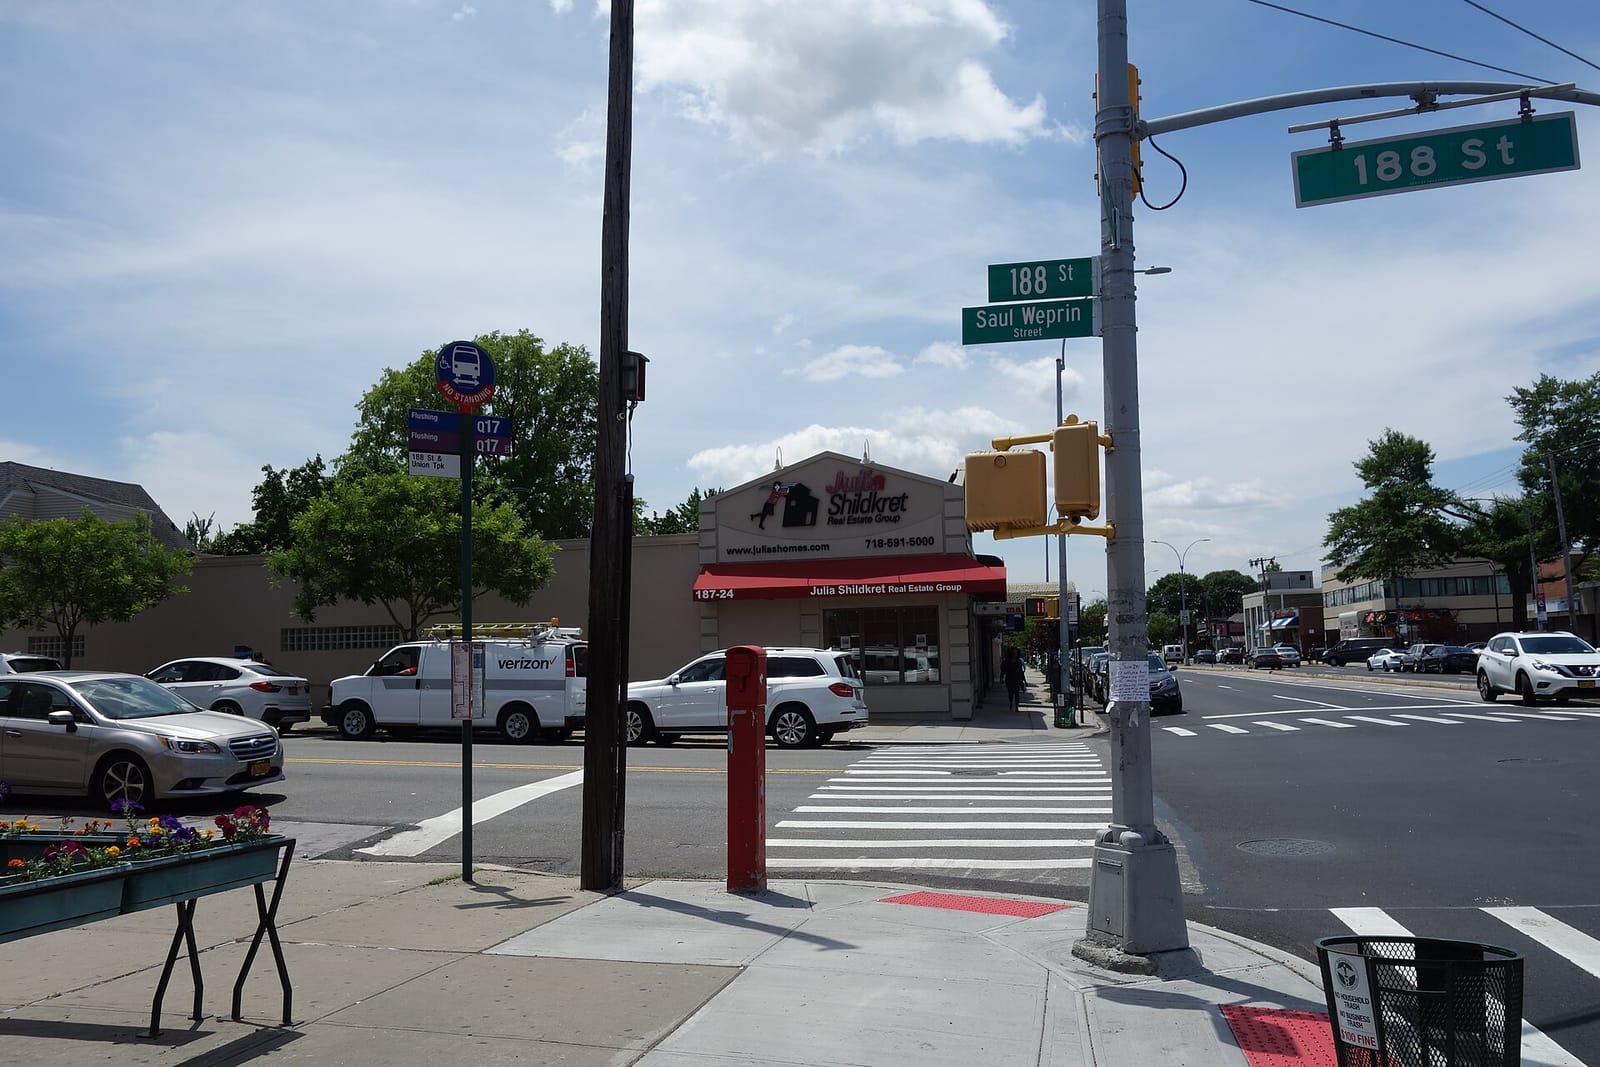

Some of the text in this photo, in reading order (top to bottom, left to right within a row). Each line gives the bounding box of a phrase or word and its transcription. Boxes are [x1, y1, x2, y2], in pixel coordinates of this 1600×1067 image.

[1353, 135, 1515, 185] 188 St
[1010, 264, 1073, 296] 188 St
[976, 304, 1081, 328] Saul Weprin
[1013, 327, 1042, 338] Street
[443, 383, 492, 404] NO STANDING
[411, 412, 438, 423] Flushing
[477, 420, 501, 435] Q17
[411, 431, 438, 442] Flushing
[476, 438, 499, 453] Q17
[412, 453, 425, 461] 188
[433, 462, 445, 470] Tpk
[825, 469, 886, 494] Julia
[827, 491, 908, 516] Shildkret
[827, 513, 900, 525] Real Estate Group
[865, 536, 935, 549] 718-591-5000
[726, 543, 830, 556] www.juliashomes.com
[695, 588, 734, 599] 187-24
[810, 583, 962, 596] Julia Shildkret Real Estate Group
[498, 656, 550, 670] verizon
[1341, 994, 1369, 1004] HOUSEHOLD
[1344, 1001, 1361, 1010] TRASH
[1340, 1010, 1371, 1023] NO BUSINESS
[1347, 1019, 1364, 1029] TRASH
[1341, 1029, 1377, 1047] $100 FINE
